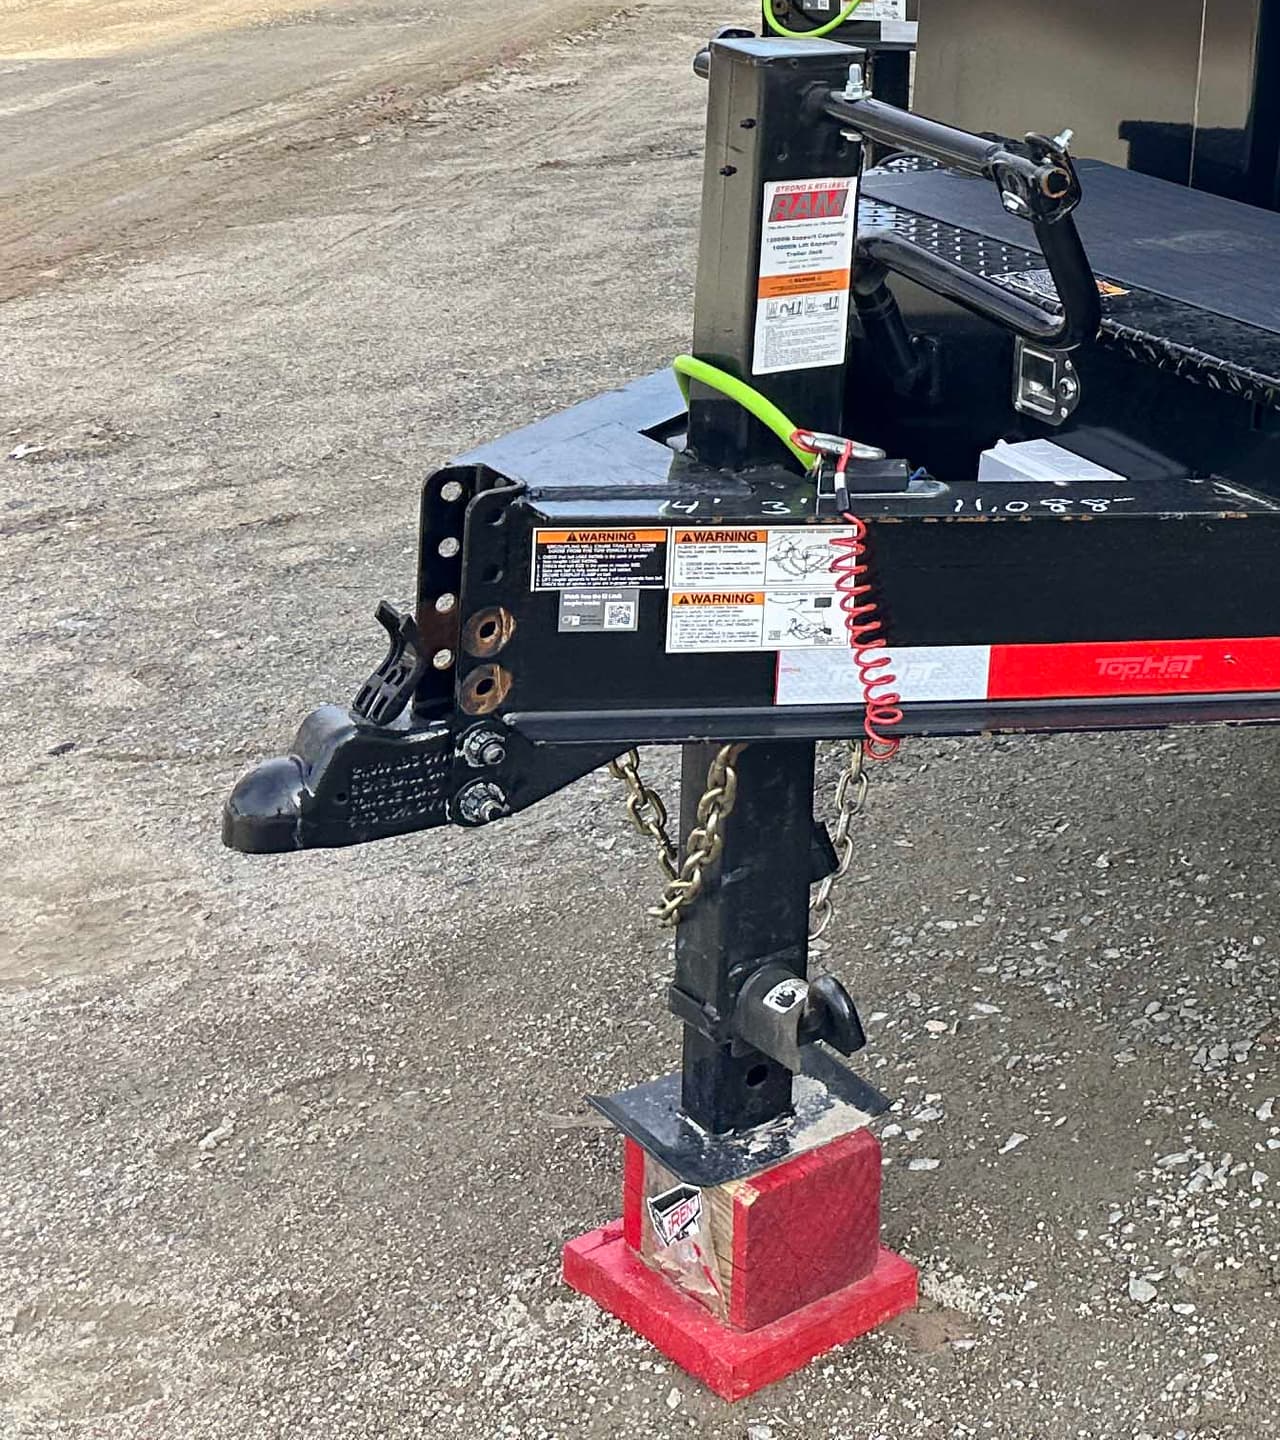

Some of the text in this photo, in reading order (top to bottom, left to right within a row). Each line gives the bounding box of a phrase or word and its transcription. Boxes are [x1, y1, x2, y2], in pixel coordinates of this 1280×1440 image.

[768, 190, 847, 223] RAM
[579, 531, 636, 542] WARNING
[693, 531, 758, 543] WARNING
[690, 593, 755, 605] WARNING
